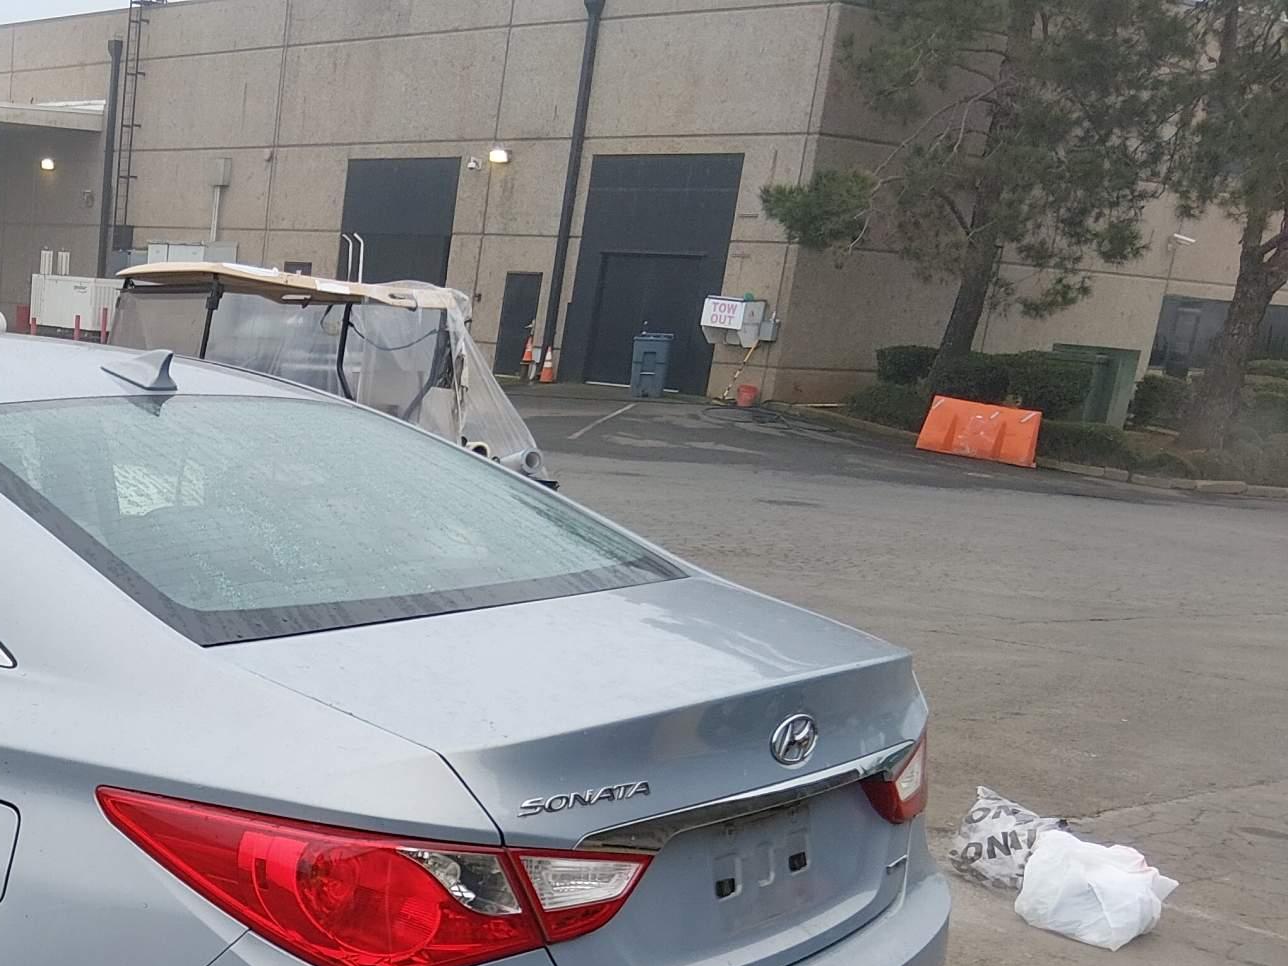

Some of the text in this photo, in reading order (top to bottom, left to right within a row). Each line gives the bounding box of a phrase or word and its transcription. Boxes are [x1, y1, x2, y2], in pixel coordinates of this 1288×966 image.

[711, 302, 738, 314] TOW
[710, 313, 735, 325] OUT
[517, 780, 651, 818] SONATA
